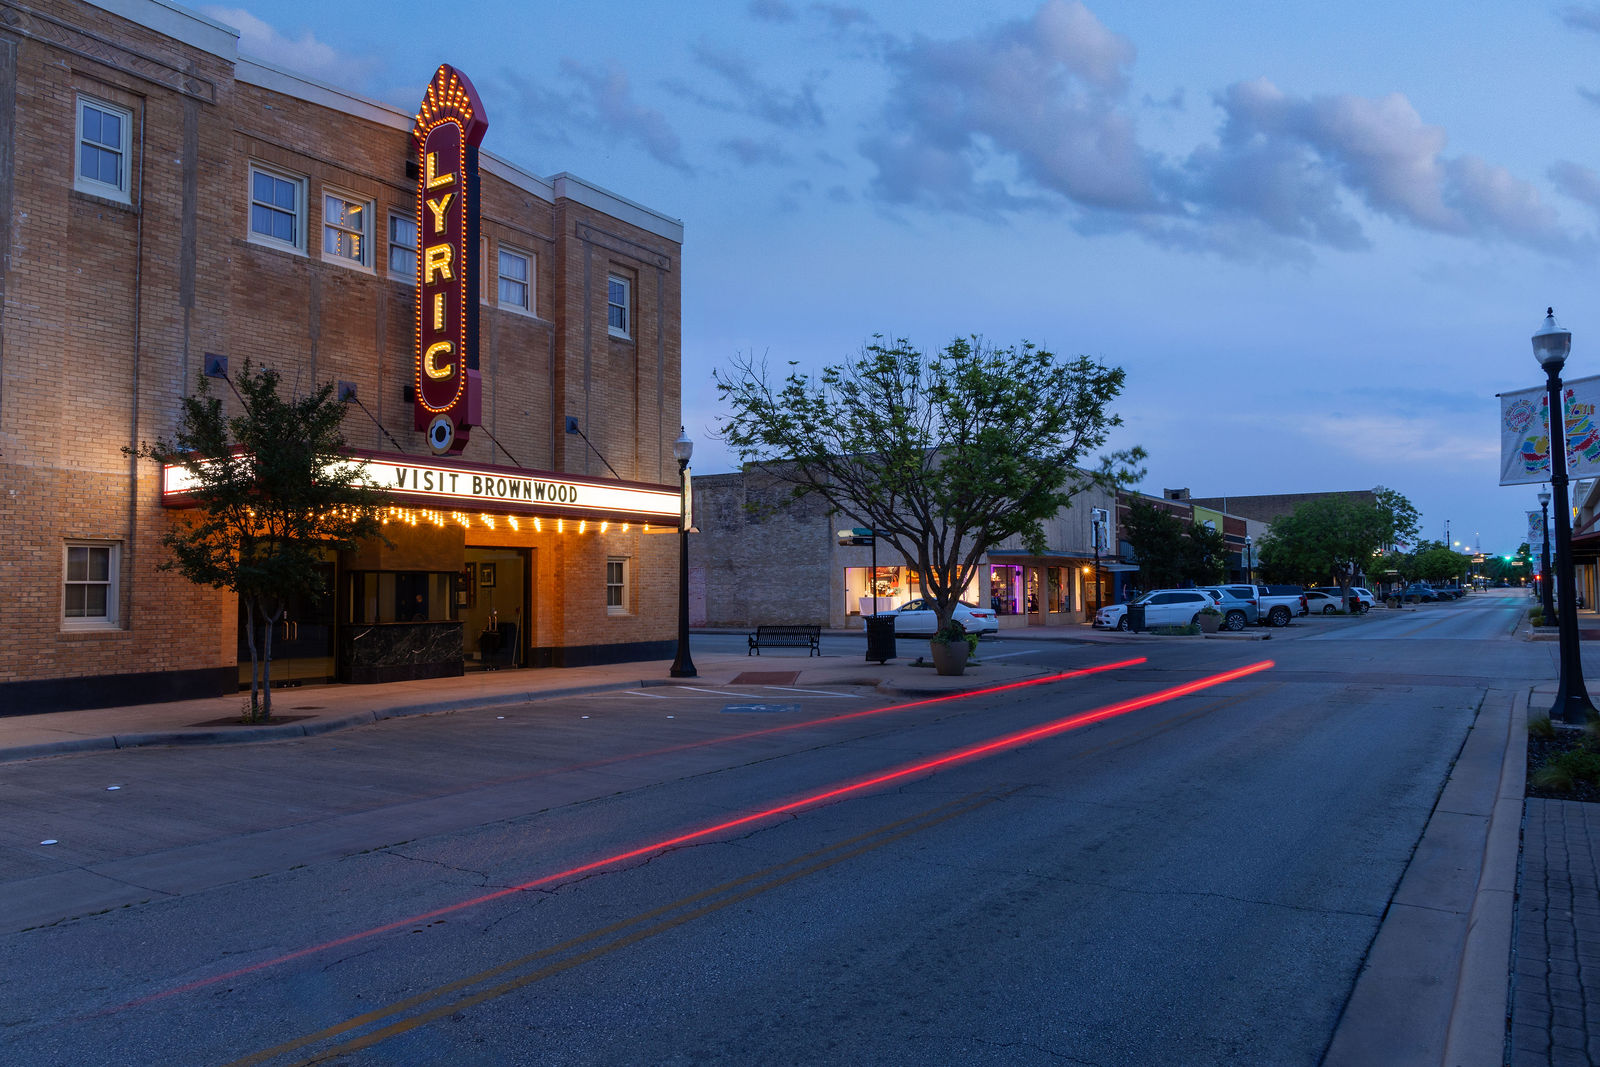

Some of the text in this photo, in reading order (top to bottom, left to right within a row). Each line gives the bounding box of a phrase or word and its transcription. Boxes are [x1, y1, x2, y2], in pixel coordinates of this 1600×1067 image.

[424, 151, 458, 382] LYRIC
[396, 467, 578, 503] VISIT BROWNWOOD
